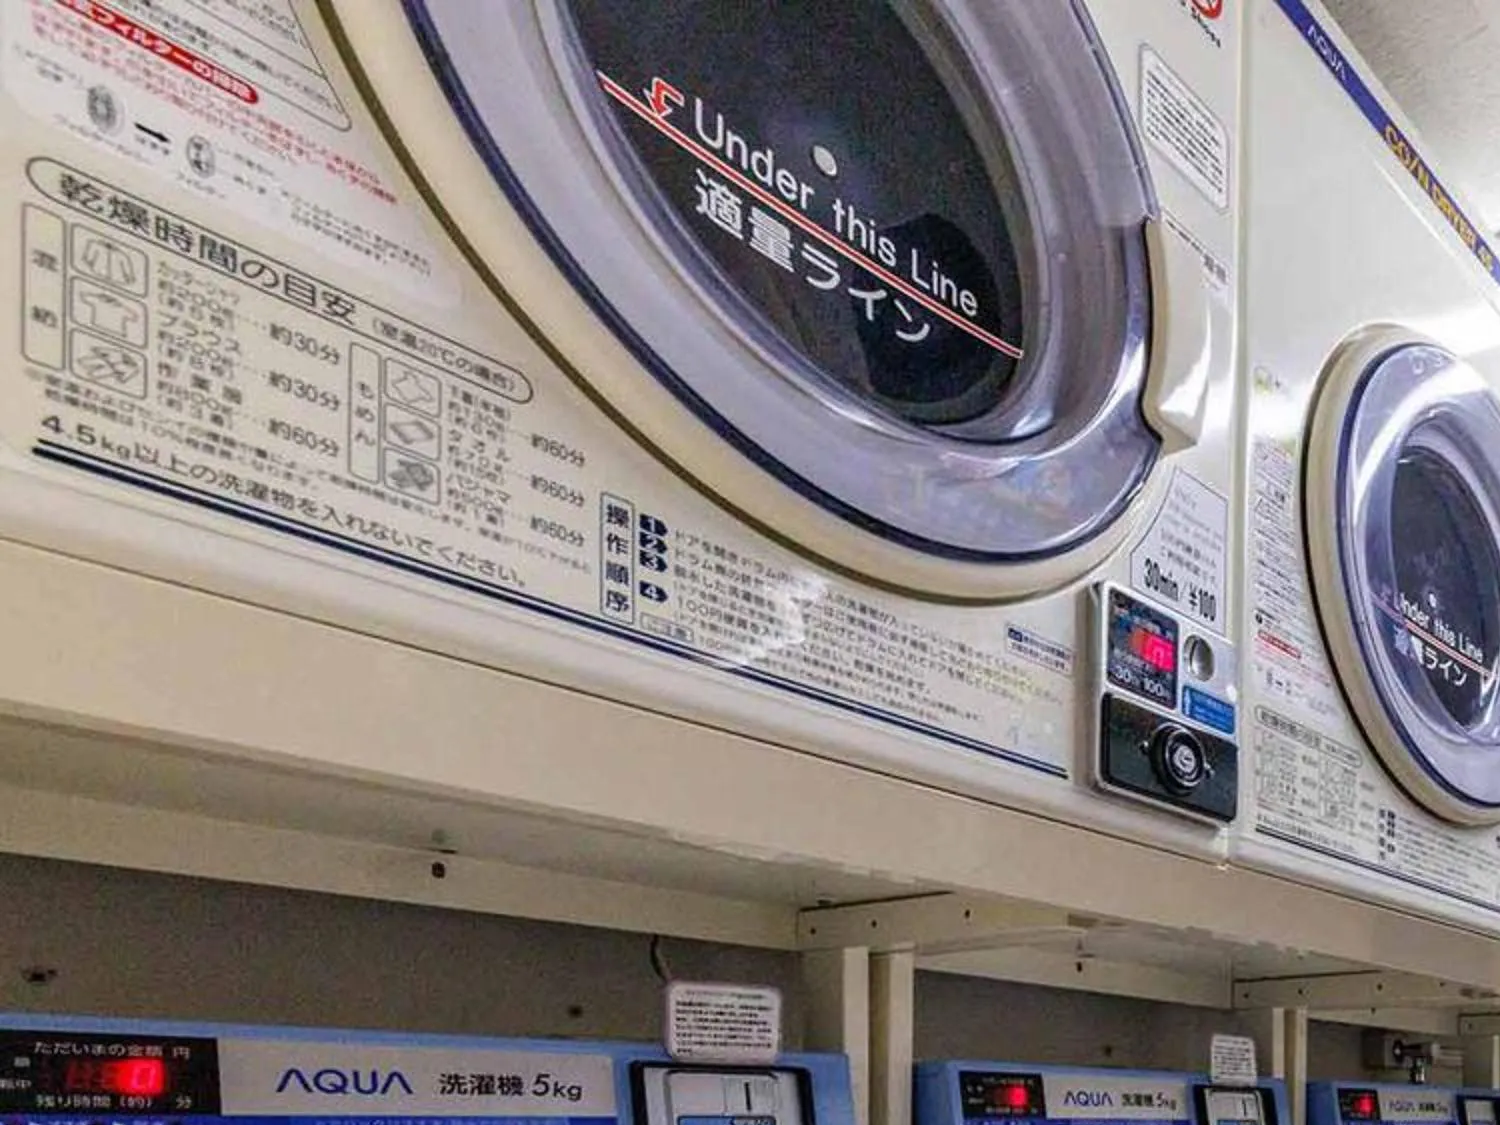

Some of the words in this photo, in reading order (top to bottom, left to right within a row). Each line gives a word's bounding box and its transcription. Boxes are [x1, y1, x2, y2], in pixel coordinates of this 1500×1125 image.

[60, 169, 356, 327] 乾燥時間の目安
[695, 98, 814, 210] Under
[833, 199, 896, 267] this
[911, 249, 978, 317] Line
[696, 168, 929, 343] 適量ライン
[42, 414, 528, 588] 4.5kg以上の洗濯物を入れないでください。
[605, 503, 631, 612] 操作順序
[275, 1068, 414, 1096] AQUA
[438, 1072, 525, 1097] 洗濯機
[531, 1072, 583, 1102] 5kg
[1064, 1090, 1114, 1108] AQUA
